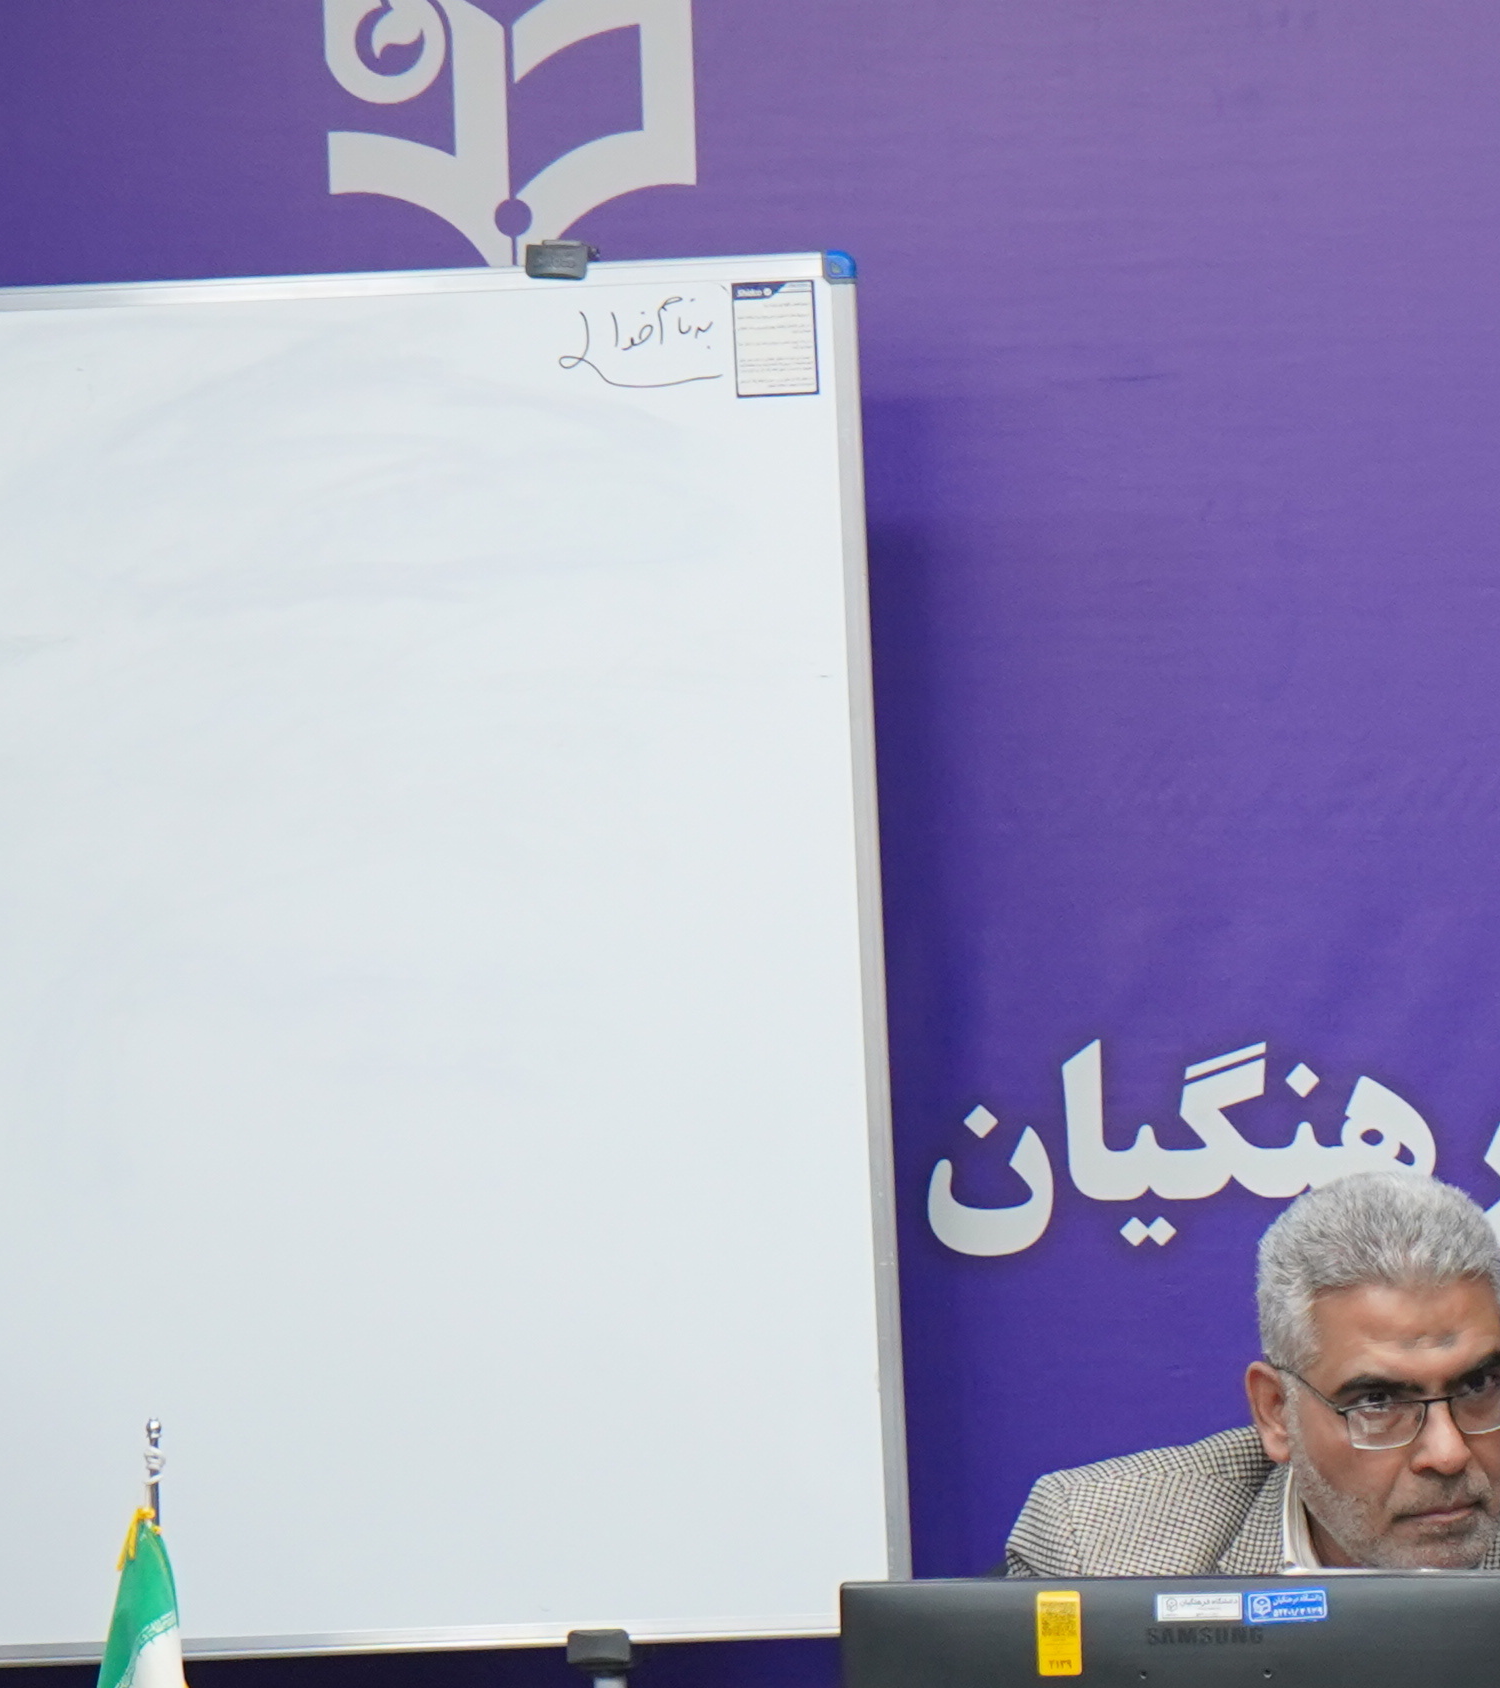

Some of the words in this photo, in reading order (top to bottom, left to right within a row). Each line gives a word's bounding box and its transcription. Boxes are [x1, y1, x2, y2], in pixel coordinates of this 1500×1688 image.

[610, 310, 654, 351] خدا
[657, 296, 696, 345] نام
[1148, 1627, 1264, 1645] SAMSUNG
